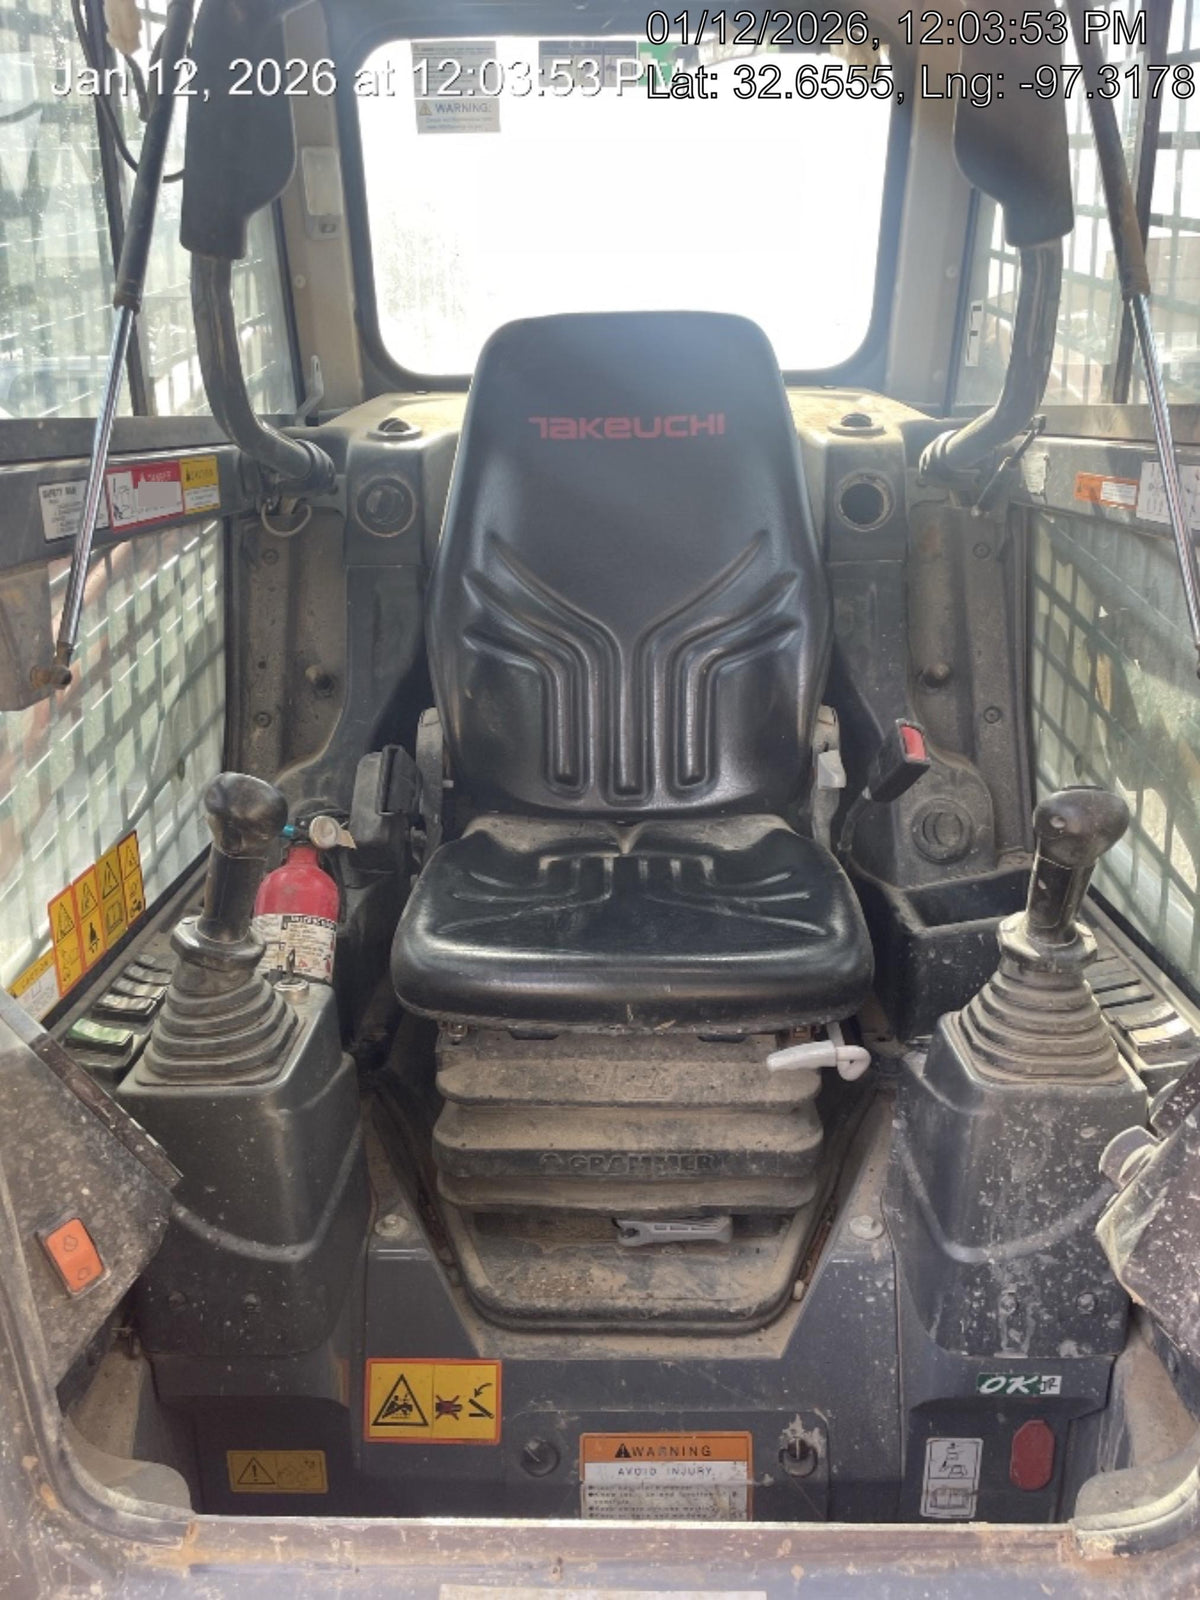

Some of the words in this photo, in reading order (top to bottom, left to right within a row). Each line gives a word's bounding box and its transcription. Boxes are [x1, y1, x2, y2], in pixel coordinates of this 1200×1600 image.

[979, 1375, 1039, 1395] OK
[632, 1445, 712, 1457] WARNING
[618, 1467, 657, 1476] AVOID
[667, 1466, 712, 1476] INJURY
